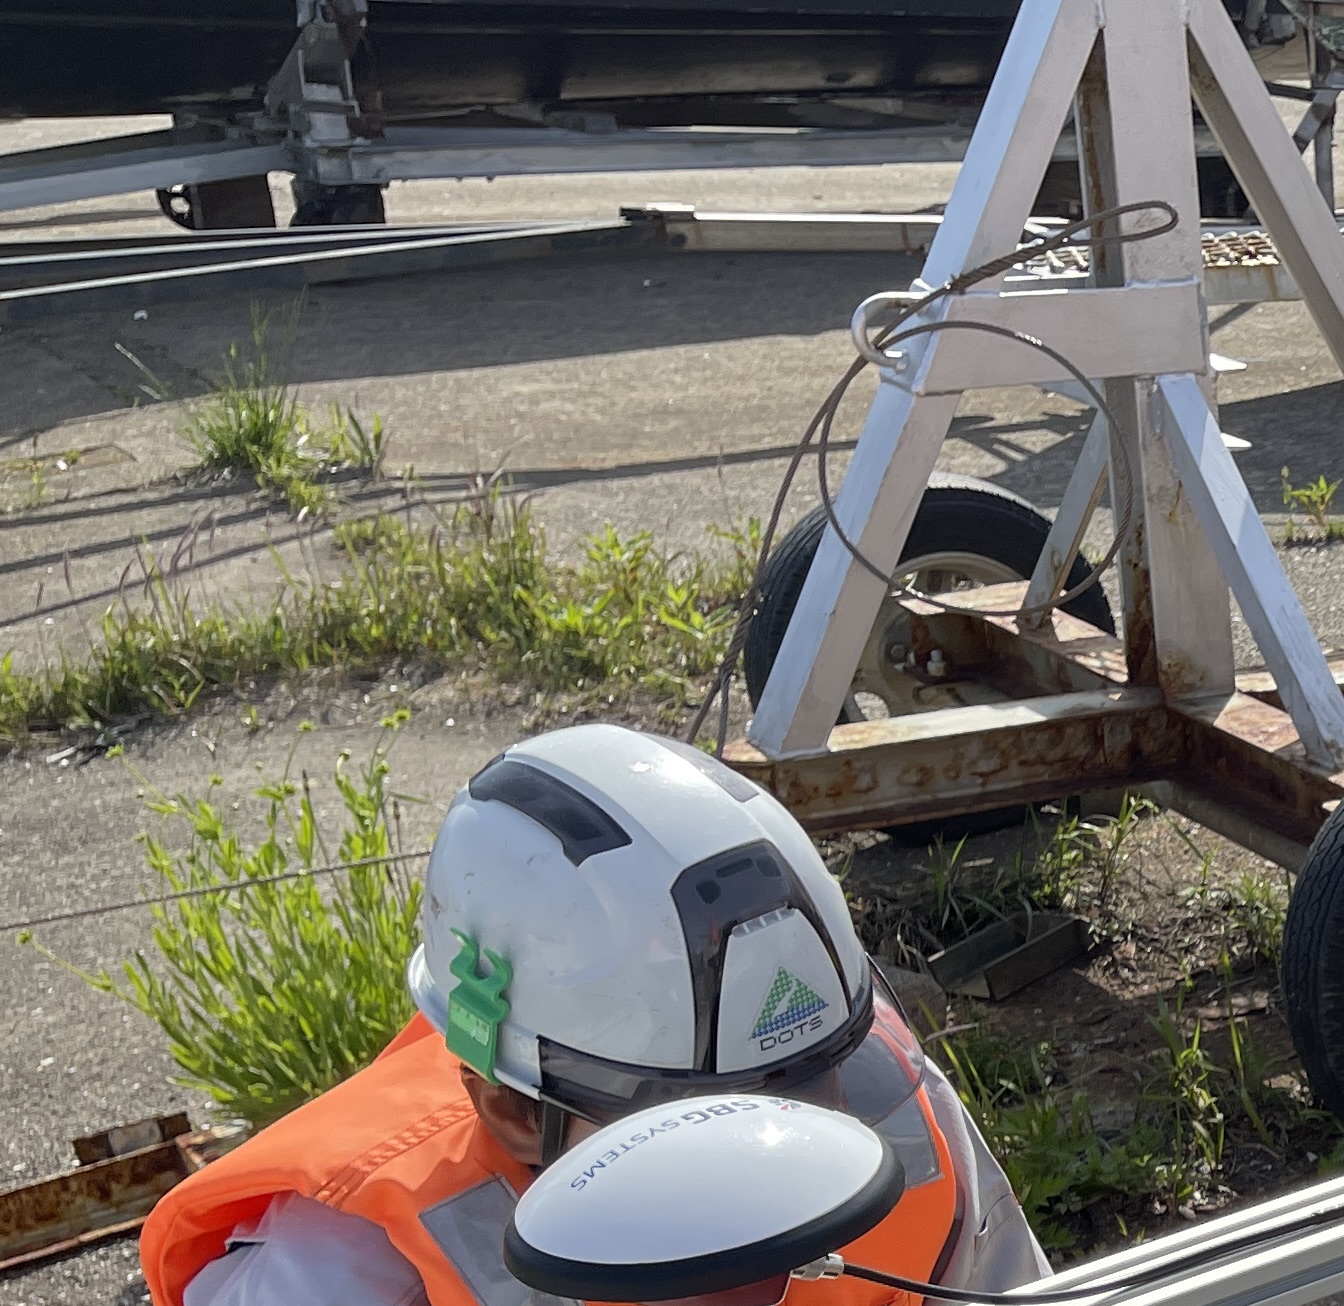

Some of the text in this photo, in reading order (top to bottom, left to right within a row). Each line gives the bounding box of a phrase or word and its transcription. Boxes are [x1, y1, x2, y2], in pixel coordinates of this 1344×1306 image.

[760, 1015, 823, 1051] DOTS
[570, 1099, 760, 1191] SBG SYSTEMS
